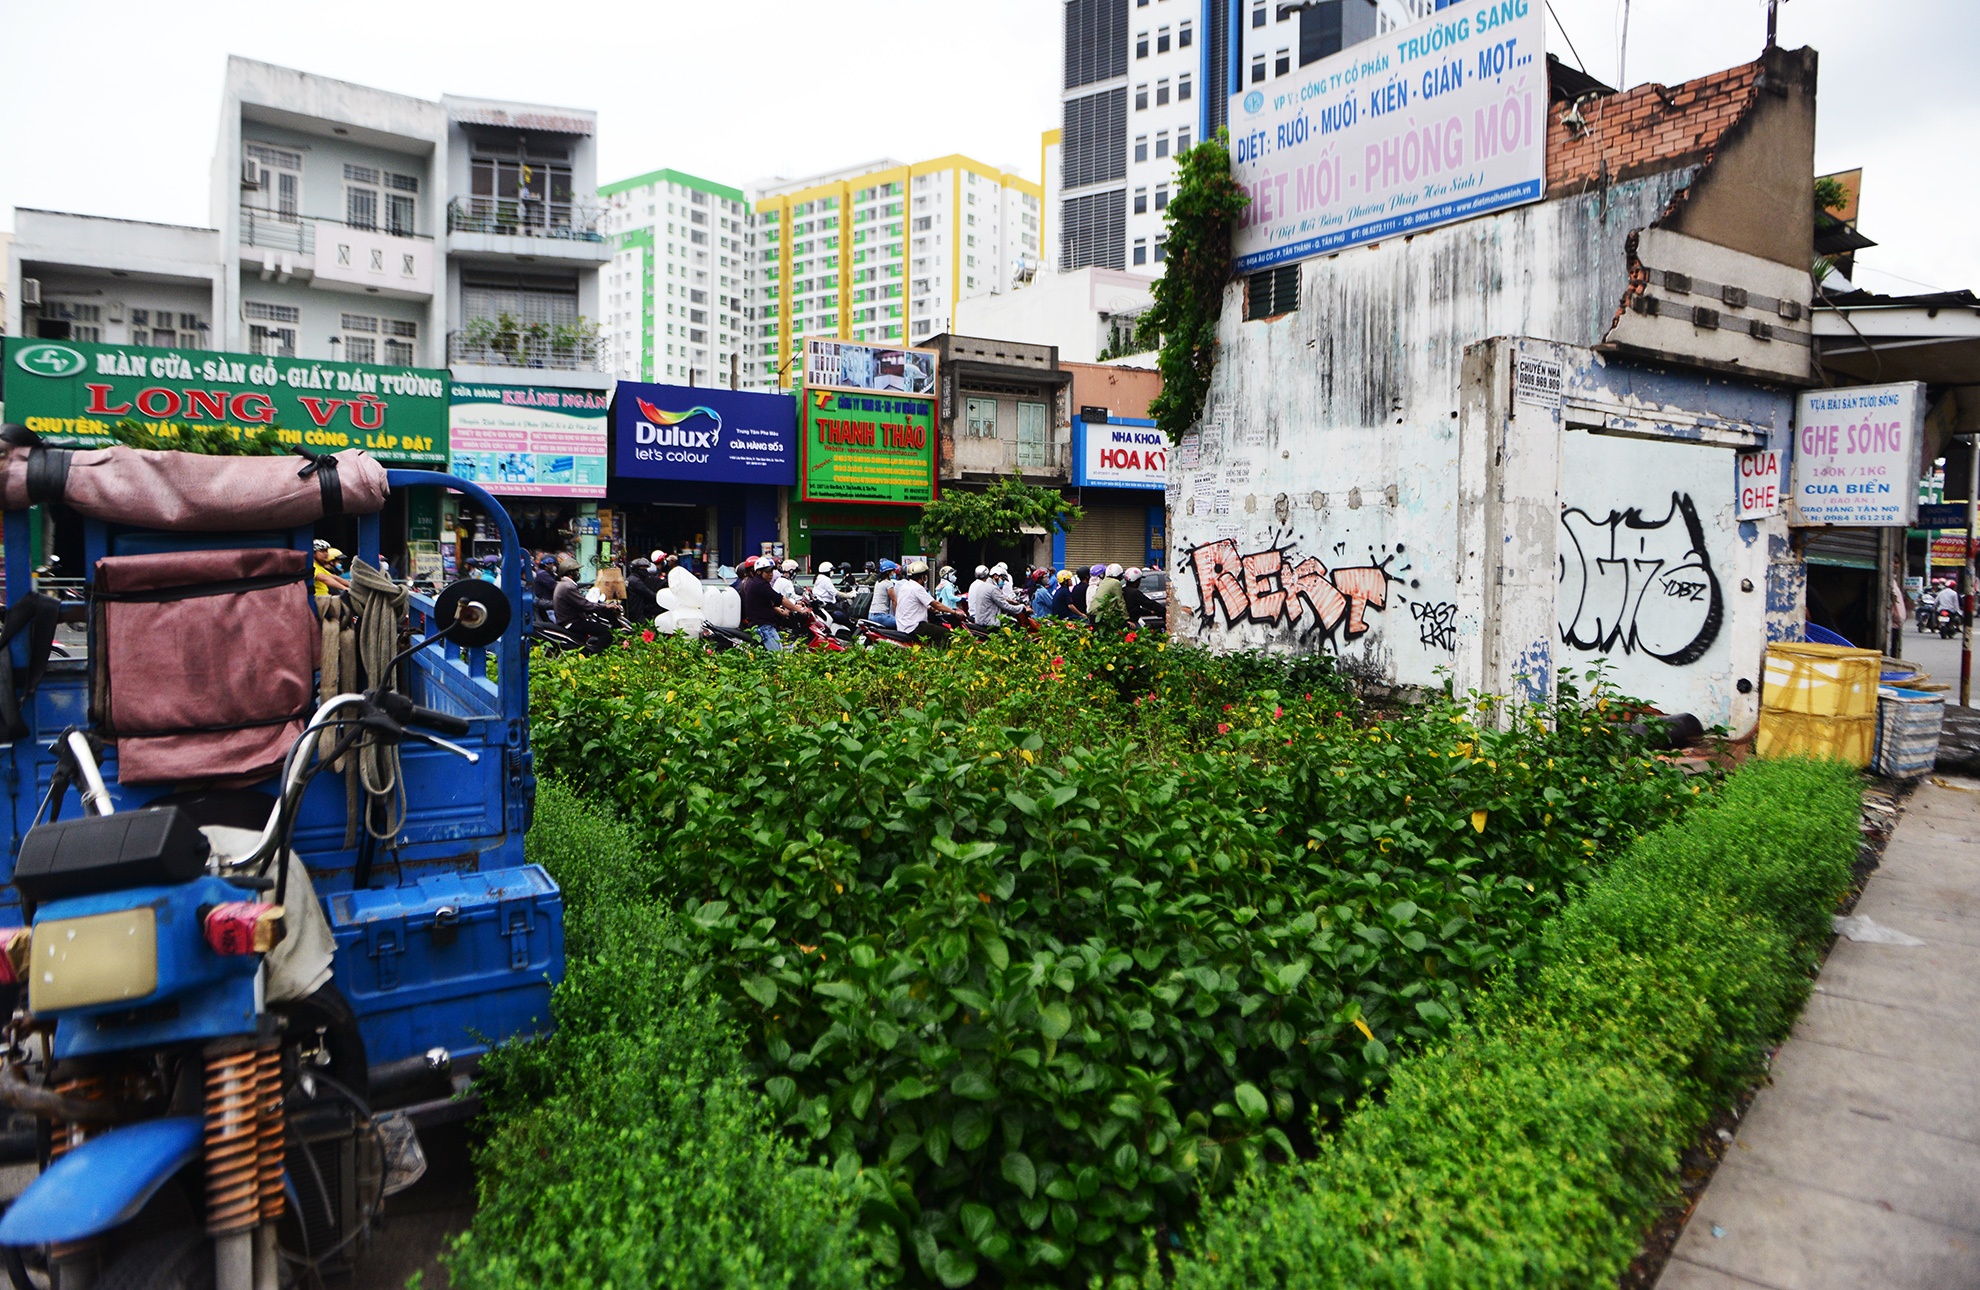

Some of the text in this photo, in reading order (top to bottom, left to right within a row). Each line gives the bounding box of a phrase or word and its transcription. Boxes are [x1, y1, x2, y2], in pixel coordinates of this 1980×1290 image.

[1301, 79, 1327, 101] CÔNG
[1330, 73, 1343, 88] TY
[1476, 0, 1529, 34] SANG
[1237, 128, 1271, 168] DIỆT:
[1371, 73, 1408, 118] KIẾN
[1422, 56, 1463, 100] GIÁN
[1236, 166, 1289, 237] DIỆT
[1296, 141, 1341, 213] MỐI
[1365, 116, 1464, 193] PHÒNG
[1474, 76, 1533, 162] MỐI
[1450, 173, 1475, 193] Sinh
[96, 350, 147, 377] MÀN
[202, 356, 246, 384] SÀN
[249, 357, 278, 387] GỖ
[287, 363, 335, 391] GIẤY
[336, 368, 377, 394] DÁN
[84, 383, 389, 430] LONG VŨ
[502, 388, 560, 407] KHÁNH
[304, 428, 349, 447] CÔNG
[401, 434, 433, 453] ĐẶT
[635, 421, 711, 448] Dulux
[816, 414, 927, 449] THANH THẢO
[1112, 431, 1161, 445] NHA KHOA
[1801, 411, 1901, 463] GHẸ SỐNG
[635, 447, 710, 464] let's colour
[746, 440, 767, 451] HÀNG
[1100, 448, 1141, 470] HOA
[1741, 452, 1777, 478] CUA
[1805, 478, 1890, 495] CUA BIỂN
[1826, 505, 1854, 513] HÀNG
